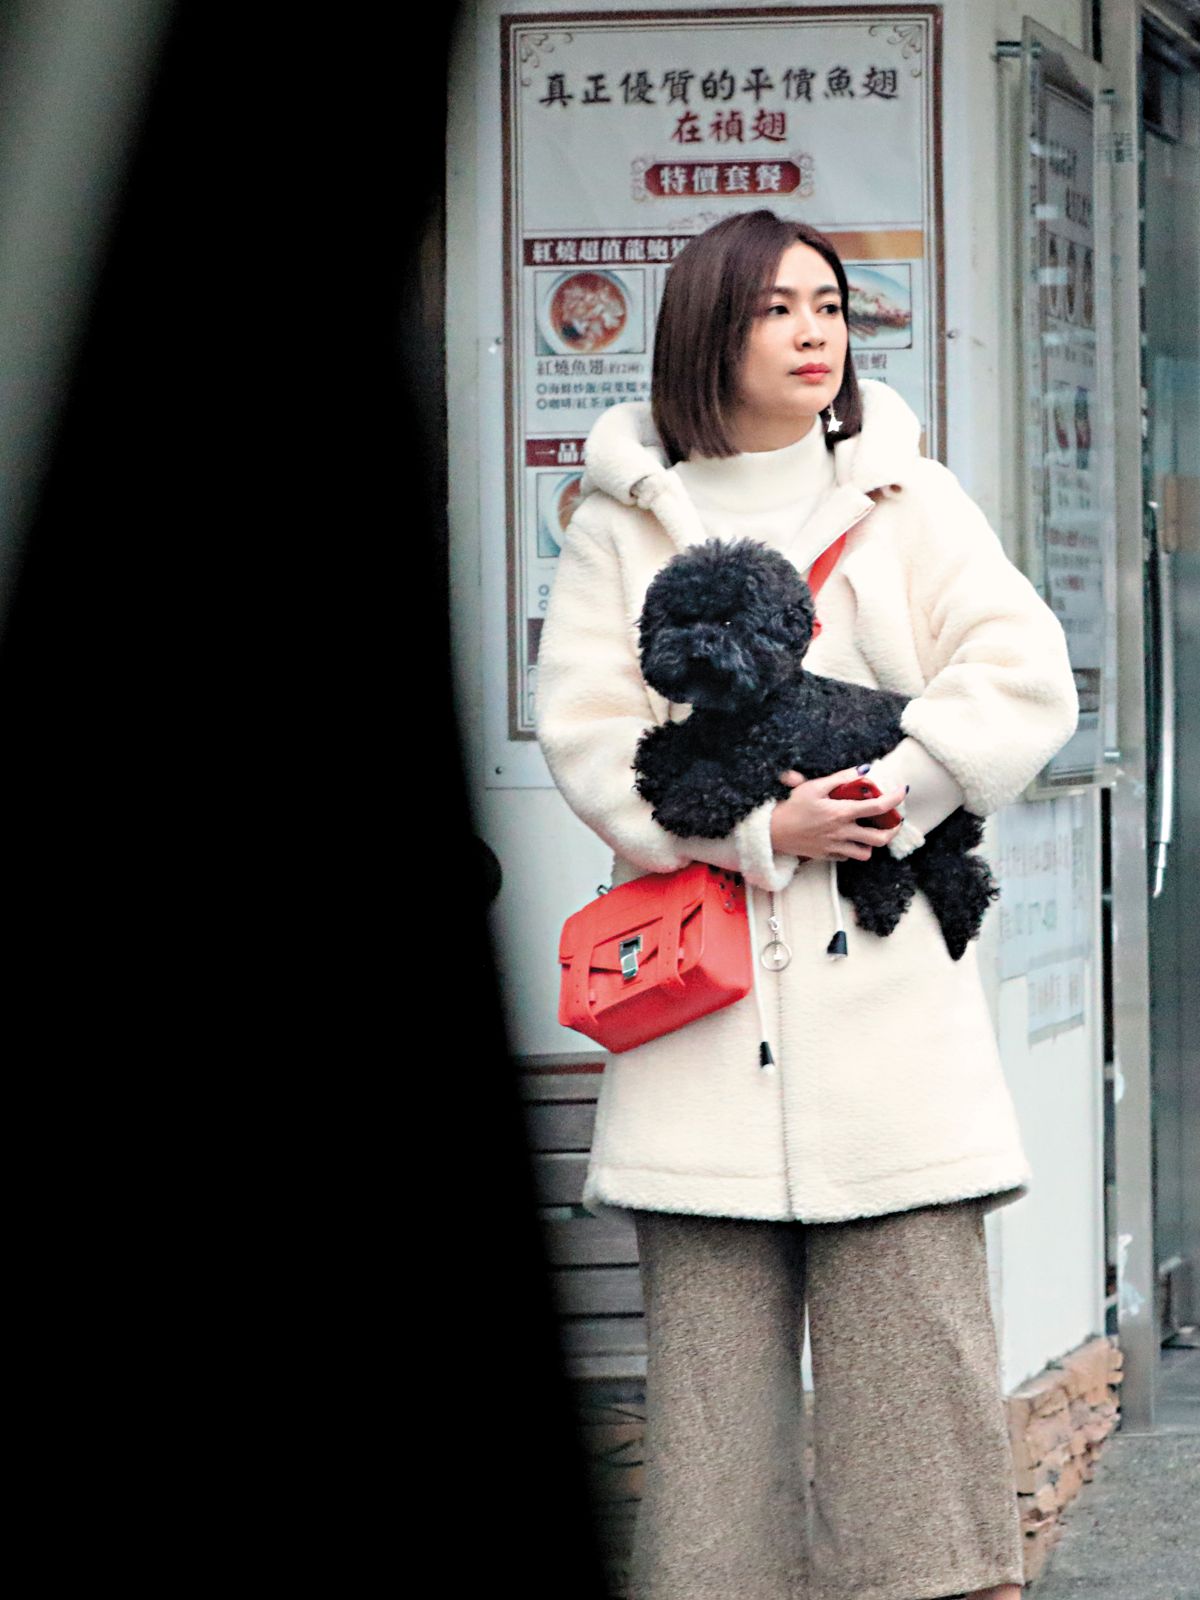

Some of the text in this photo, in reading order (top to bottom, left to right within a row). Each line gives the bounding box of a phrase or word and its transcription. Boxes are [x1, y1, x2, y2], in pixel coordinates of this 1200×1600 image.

[540, 65, 898, 107] 真正優質的平價魚翅
[672, 109, 787, 143] 在禎翅
[660, 164, 782, 193] 特價套餐
